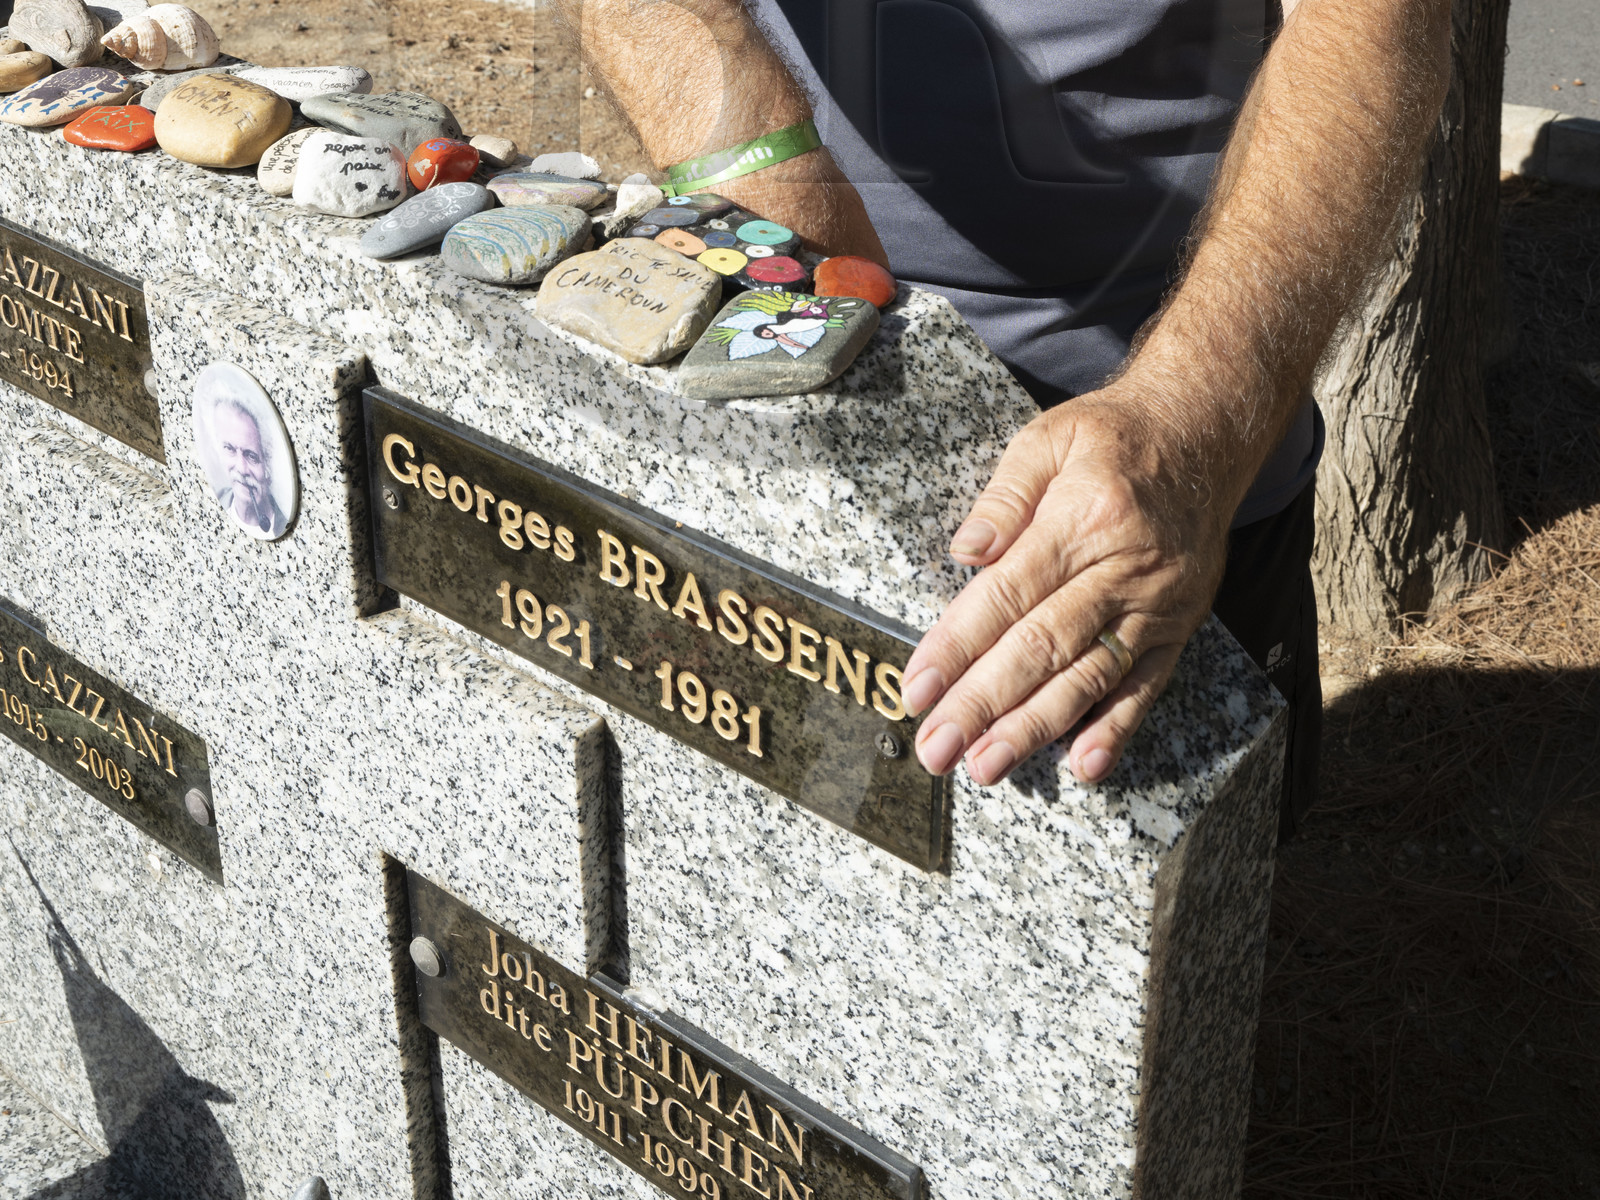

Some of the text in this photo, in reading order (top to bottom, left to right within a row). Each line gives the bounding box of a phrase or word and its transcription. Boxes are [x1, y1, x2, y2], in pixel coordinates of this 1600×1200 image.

[374, 146, 392, 155] en
[556, 268, 670, 314] CAMEROUN
[617, 267, 650, 285] DU
[18, 347, 74, 399] 1994
[382, 433, 907, 721] Georges BRASSENS
[17, 645, 178, 778] CAZZANI
[496, 580, 594, 670] 1921
[655, 660, 763, 758] 1981
[0, 687, 48, 742] 1915
[73, 736, 135, 800] 2003
[479, 980, 552, 1052] dite
[481, 926, 807, 1166] Joha HEIMAN
